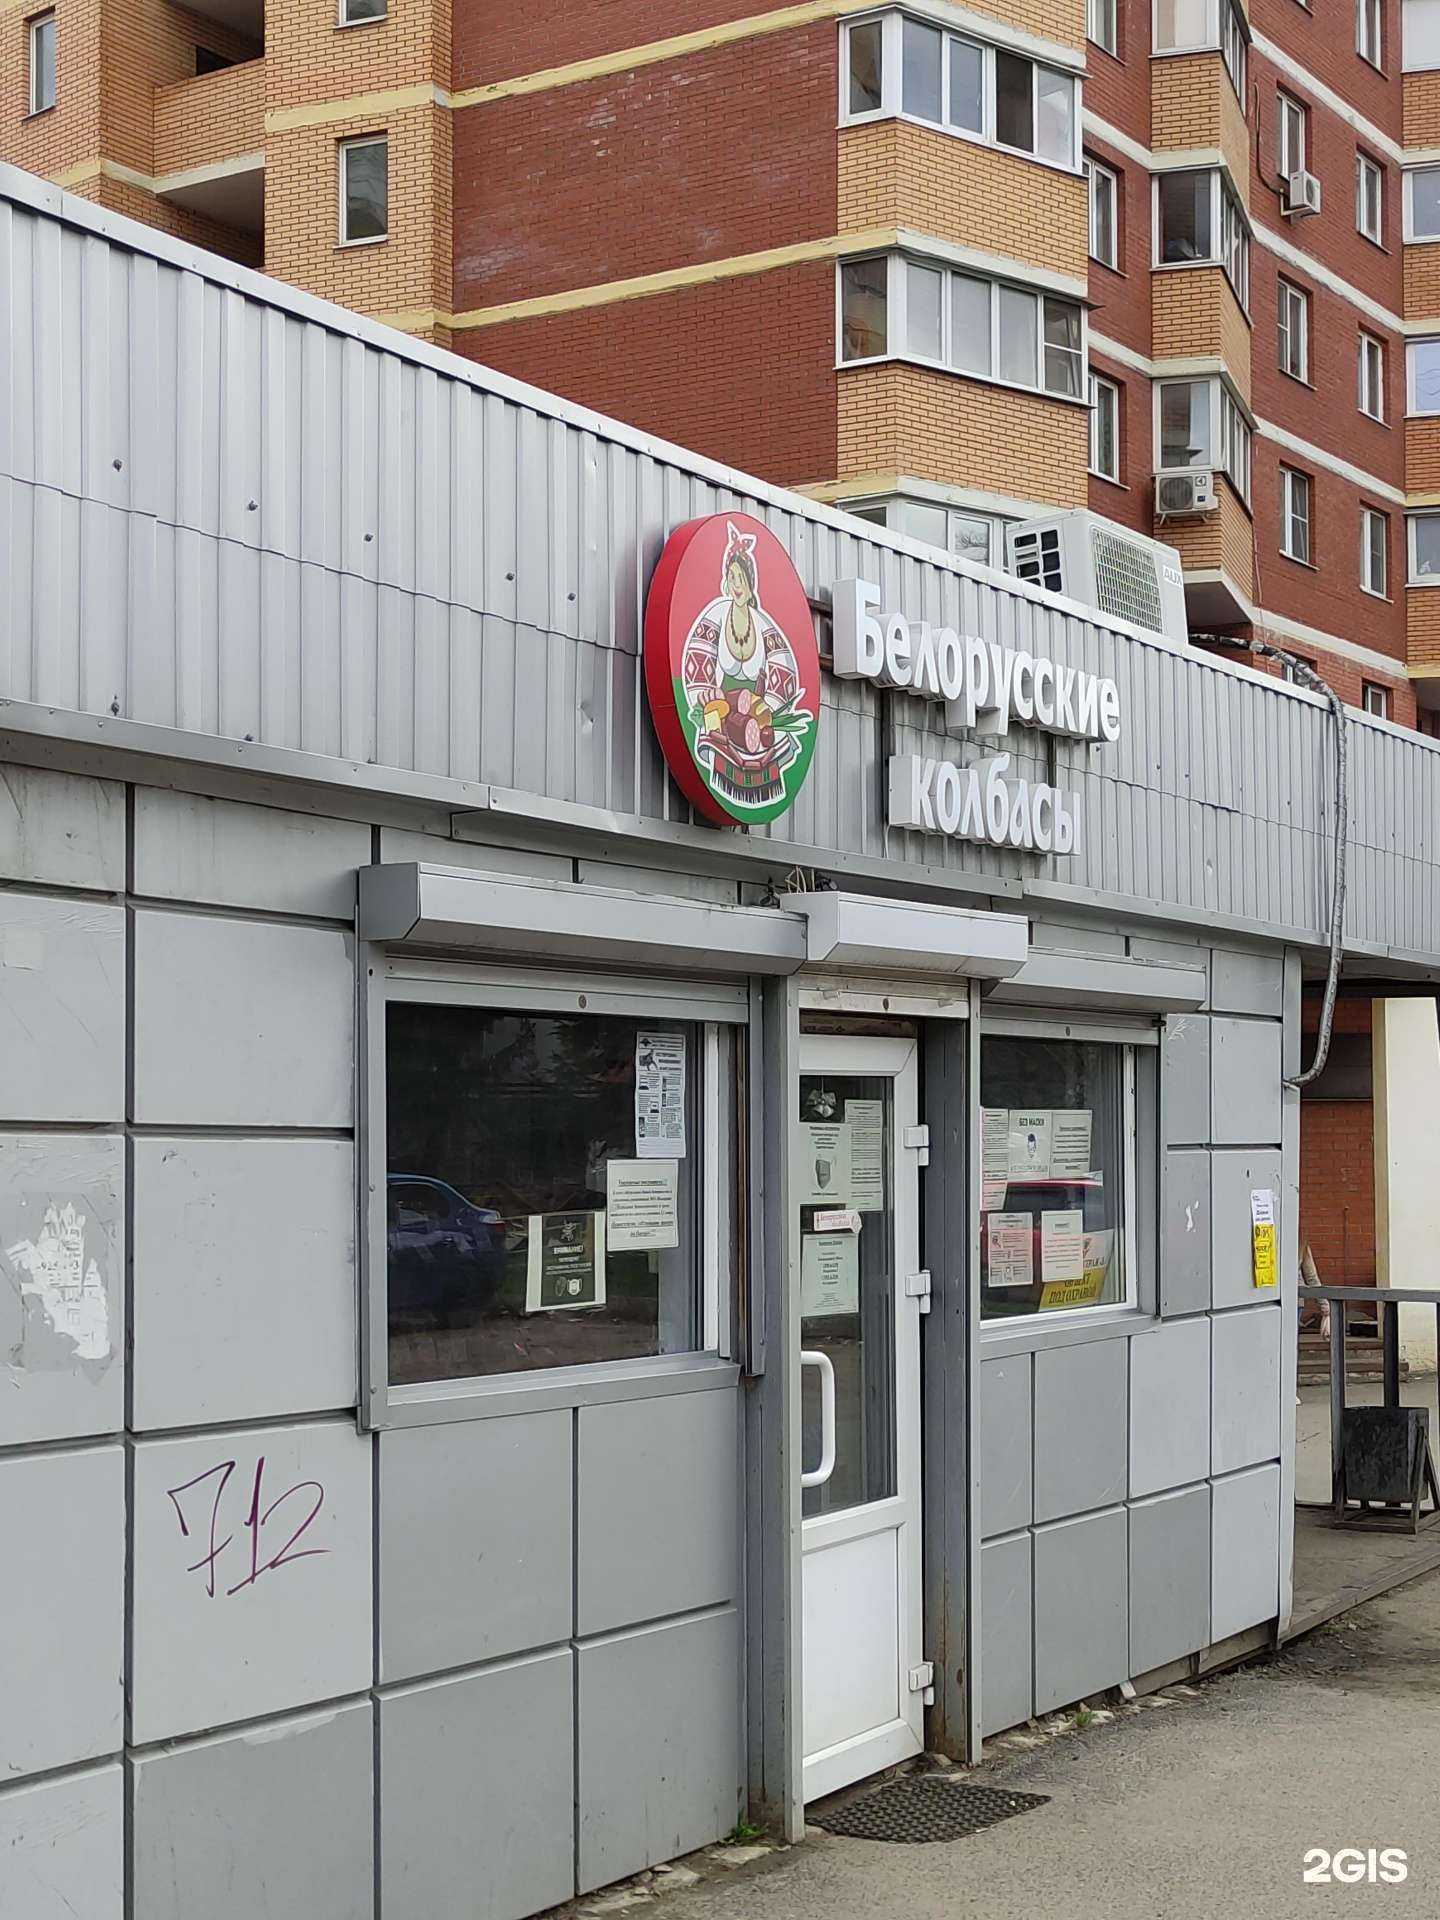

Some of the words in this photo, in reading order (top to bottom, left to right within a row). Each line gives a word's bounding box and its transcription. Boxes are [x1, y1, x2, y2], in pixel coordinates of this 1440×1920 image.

[840, 578, 1120, 742] Белорусские
[902, 752, 1080, 855] колбасы
[167, 1456, 332, 1598] 712
